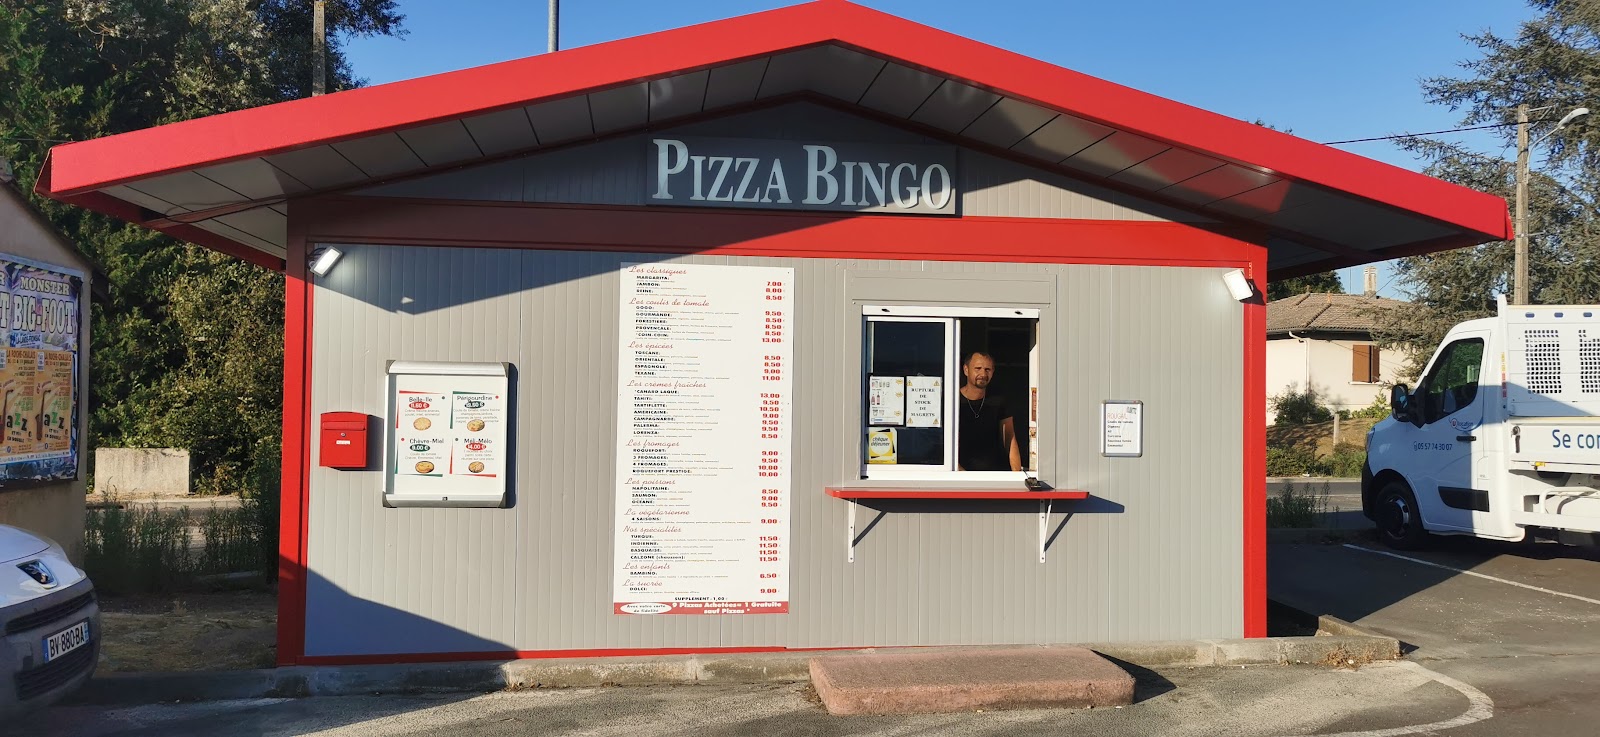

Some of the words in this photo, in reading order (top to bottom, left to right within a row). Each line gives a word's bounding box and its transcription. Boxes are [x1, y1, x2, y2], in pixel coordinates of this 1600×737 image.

[652, 138, 792, 204] PIZZA
[802, 145, 950, 210] BINGO
[647, 267, 687, 276] classiques
[20, 276, 70, 296] MONSTER
[13, 294, 74, 334] BIG-FOOT
[643, 439, 680, 448] fromages
[1552, 430, 1571, 448] Se
[640, 563, 670, 571] enfants
